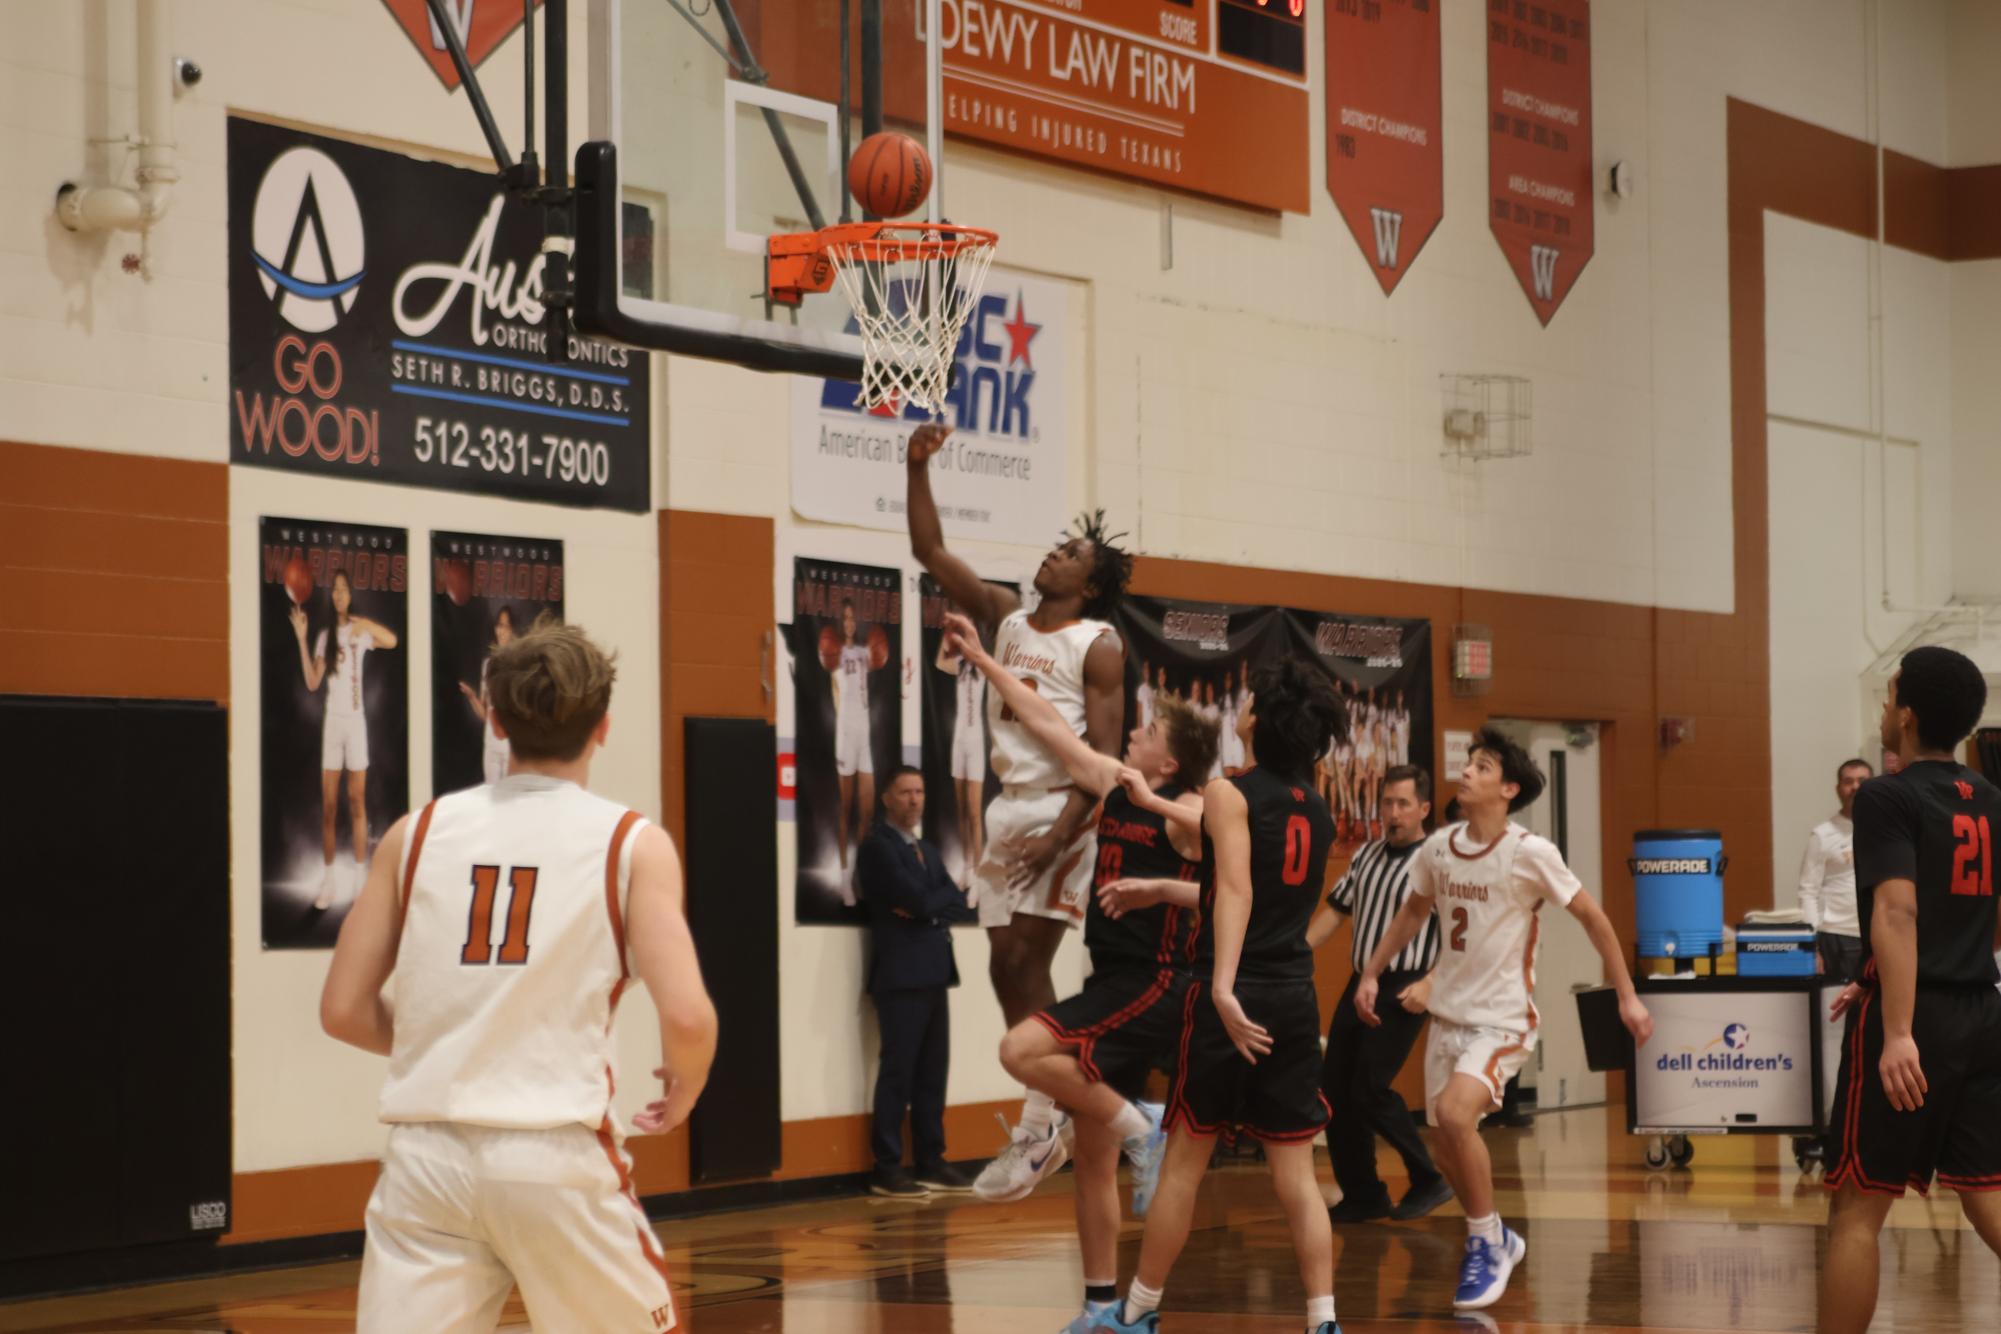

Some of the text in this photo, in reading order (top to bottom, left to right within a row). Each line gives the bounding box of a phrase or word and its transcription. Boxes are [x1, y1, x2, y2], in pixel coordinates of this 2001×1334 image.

[1159, 11, 1198, 45] SCORE
[1048, 24, 1120, 92] LAW
[1128, 46, 1196, 115] FIRM
[948, 94, 1182, 174] ELPING INJURED TEXANS
[1340, 106, 1376, 133] DISTRICT
[1378, 115, 1427, 146] CHAMPIONS
[1369, 207, 1402, 271] W
[392, 193, 576, 346] Aus
[1530, 244, 1559, 300] W
[275, 336, 343, 399] GO
[492, 325, 630, 369] ORTHOONTICS
[391, 357, 632, 414] SETH R. BRIGGS, D.D.S.
[236, 390, 381, 467] WOOD!
[413, 417, 610, 487] 512-331-7900
[818, 424, 891, 464] American
[938, 440, 955, 471] of
[957, 442, 1032, 481] Commerce
[280, 529, 393, 549] WESTWOOD
[263, 543, 407, 593] WRRIORS
[433, 556, 564, 602] WRRIORS
[1003, 641, 1056, 676] Warriors
[1282, 815, 1311, 886] 0
[1636, 858, 1710, 876] POWERADE
[1950, 814, 1993, 897] 21
[1438, 868, 1490, 903] Warriors
[459, 864, 539, 966] 11
[1449, 906, 1469, 953] 2
[1747, 941, 1800, 954] POWERADE
[1656, 1052, 1794, 1072] dell children's
[1691, 1075, 1760, 1090] Ascension
